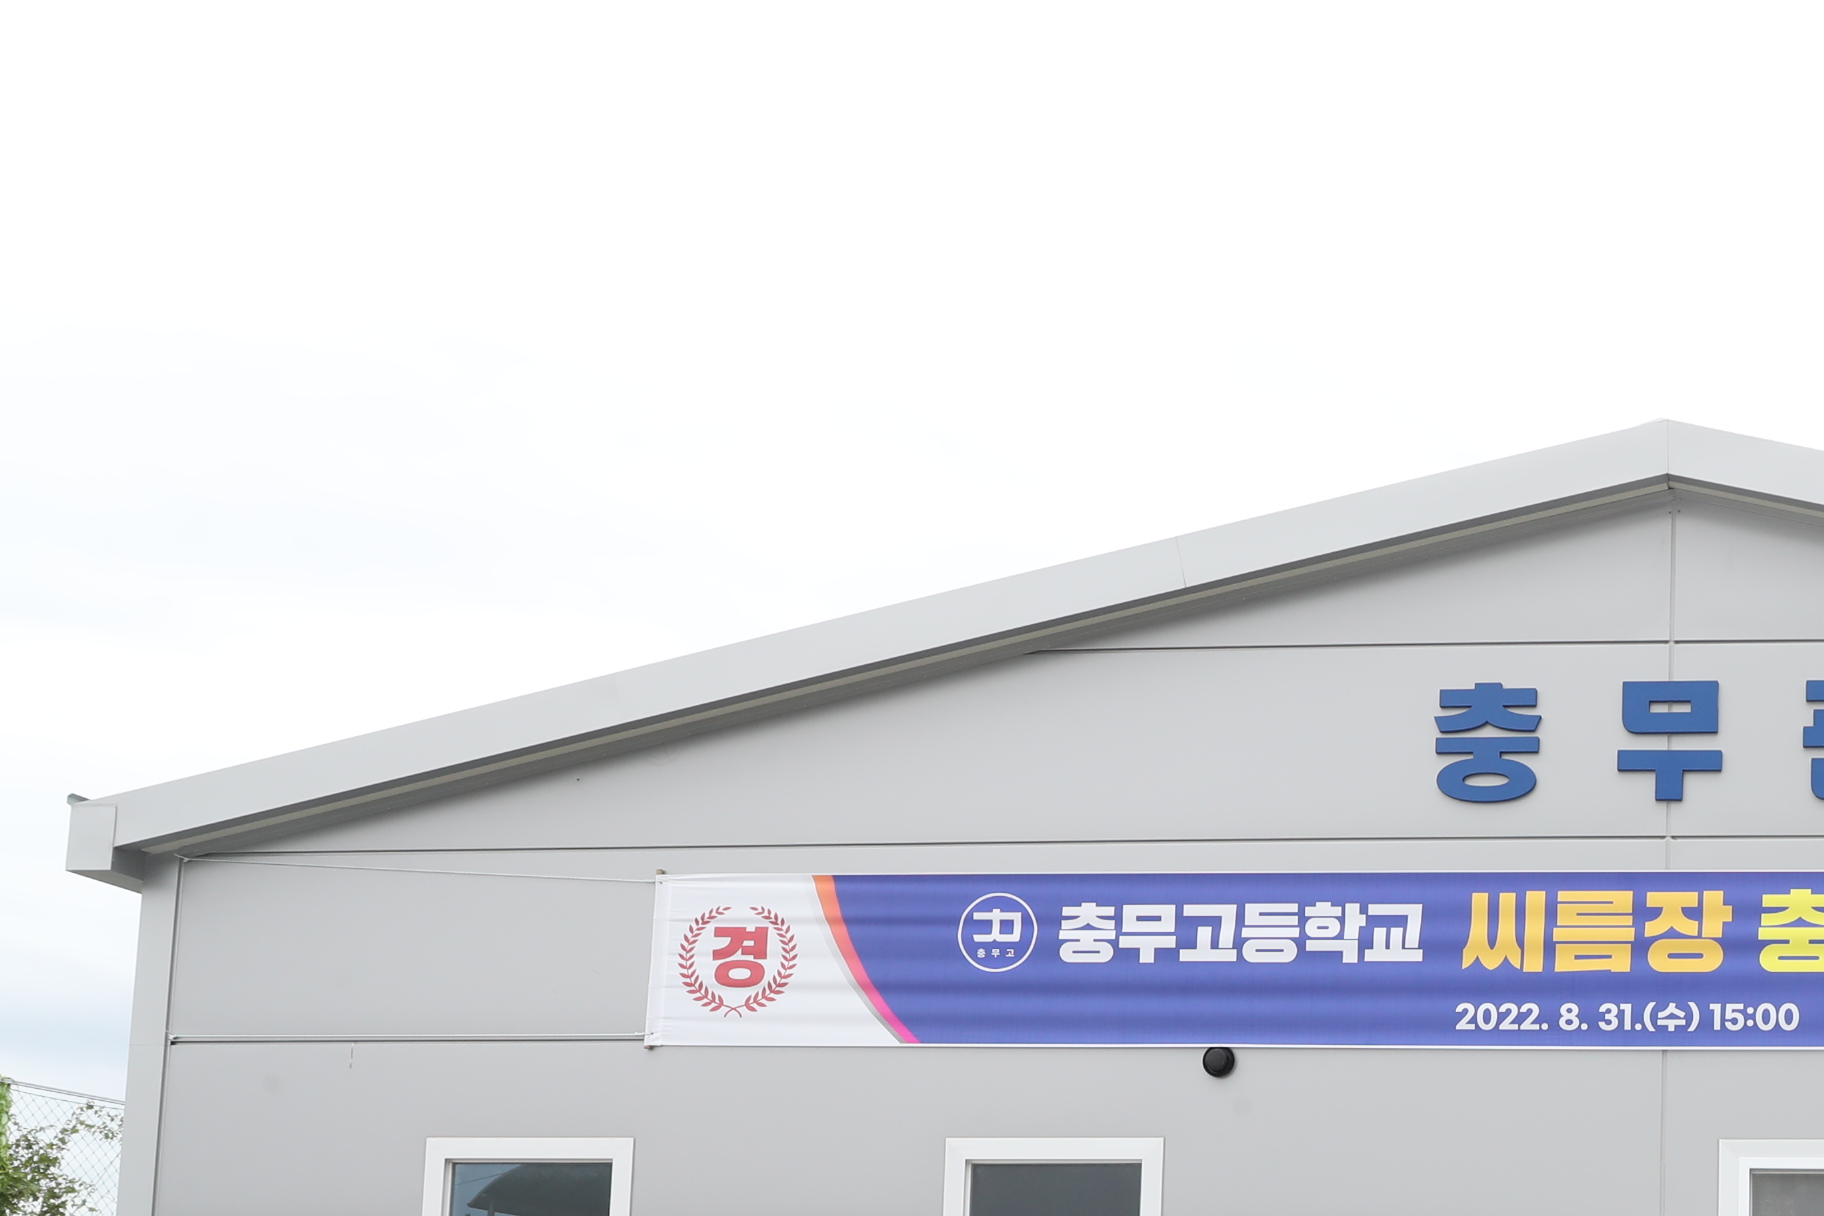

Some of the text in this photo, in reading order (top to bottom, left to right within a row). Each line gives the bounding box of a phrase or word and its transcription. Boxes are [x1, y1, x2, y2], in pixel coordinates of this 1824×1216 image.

[711, 924, 768, 987] 경
[1058, 901, 1424, 964] 충무고등학교
[1462, 888, 1733, 973] 씨름장
[1455, 1001, 1800, 1032] 2022. 8. 31.(수) 15:00
